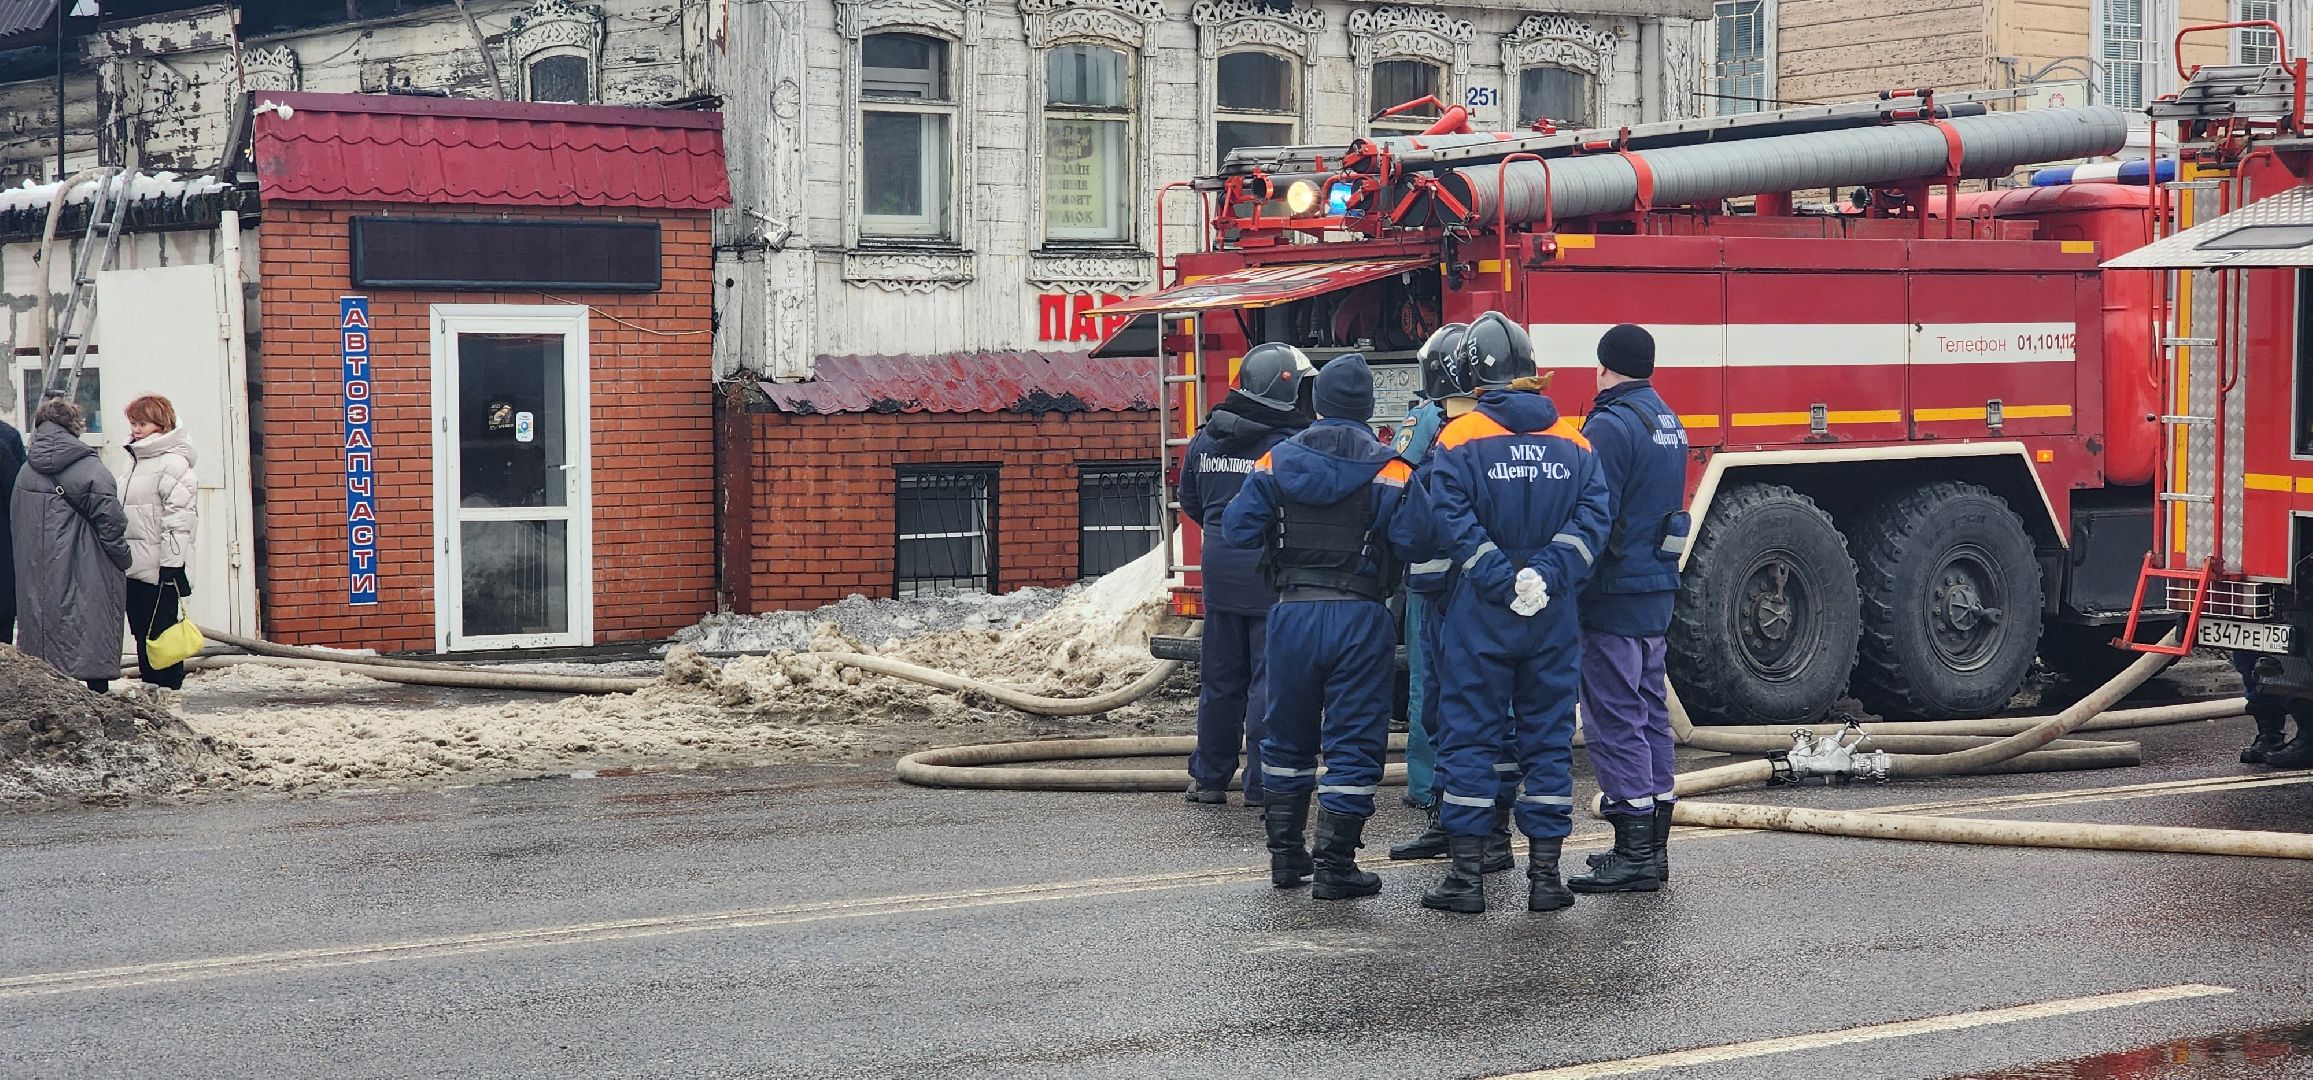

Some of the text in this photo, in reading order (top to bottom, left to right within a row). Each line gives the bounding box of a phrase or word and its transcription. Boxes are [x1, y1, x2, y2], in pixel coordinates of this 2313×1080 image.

[1467, 86, 1498, 106] 251
[1039, 294, 1140, 342] ПАР
[1467, 337, 1479, 366] ПСО
[1937, 336, 2006, 356] Телефон
[342, 308, 375, 593] АВТОЗАПЧАСТИ
[1509, 444, 1546, 462] МКУ
[1487, 462, 1571, 483] «Центр ЧС»
[2265, 626, 2289, 643] 750
